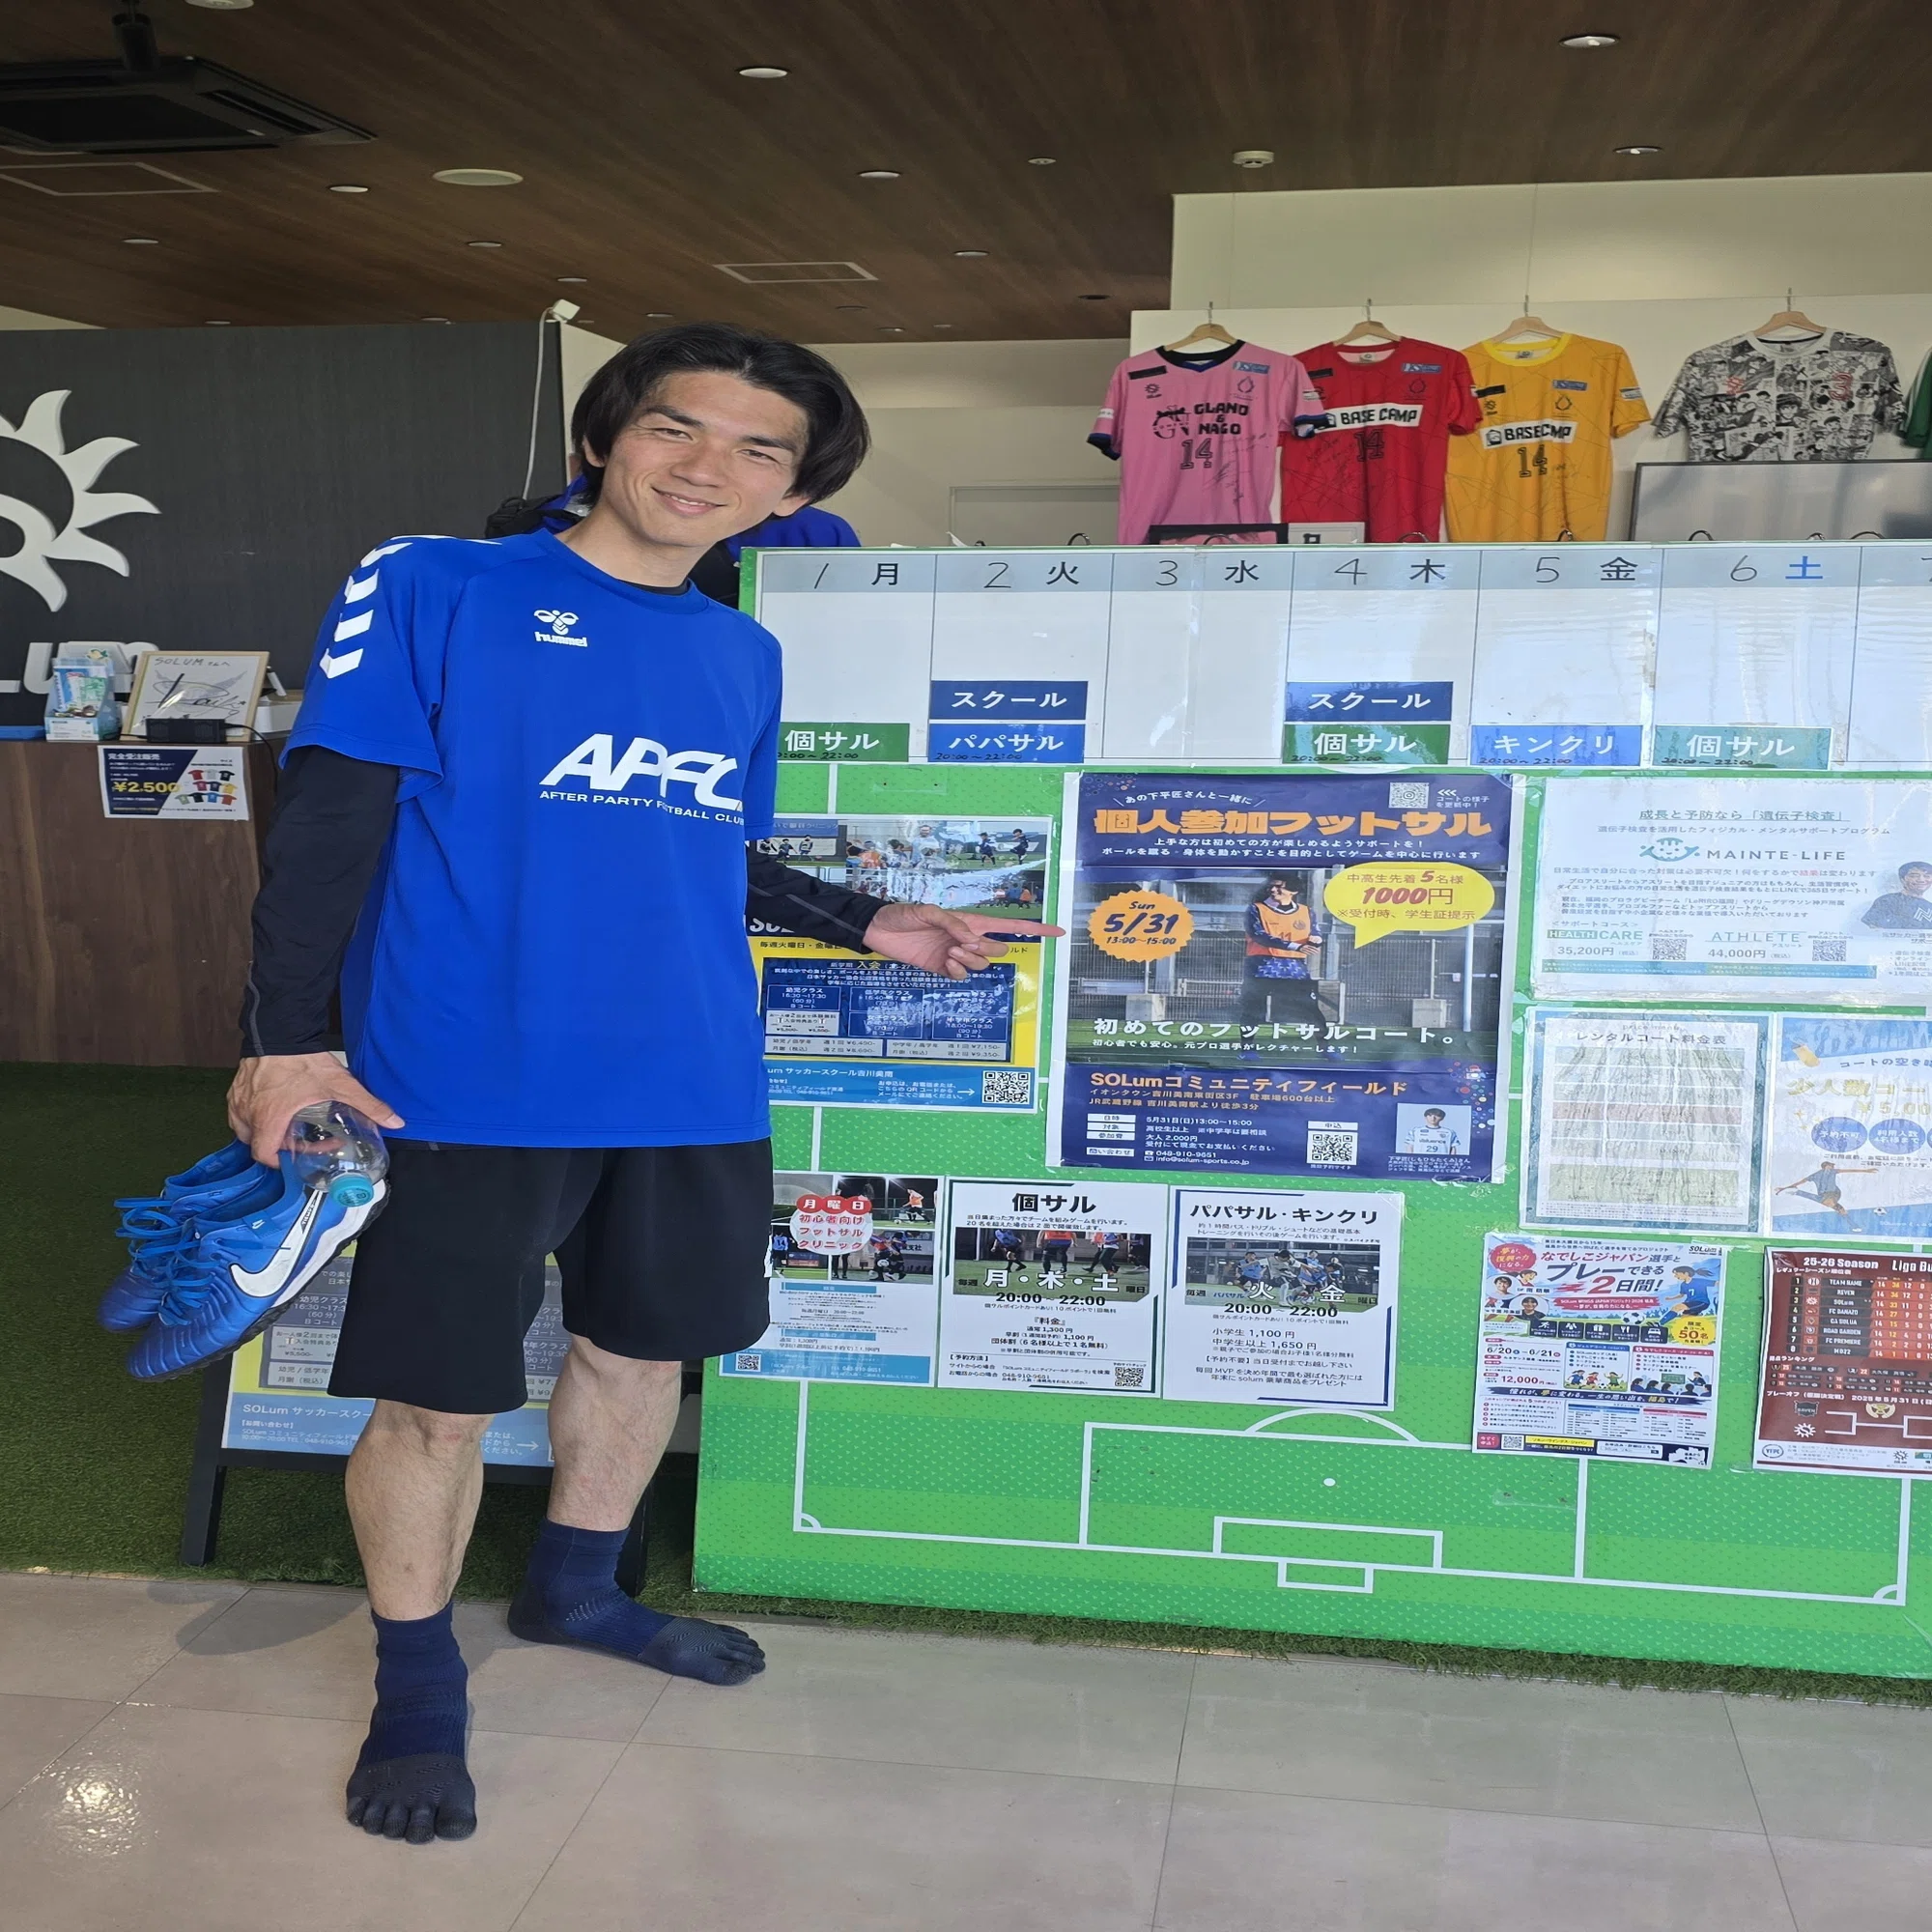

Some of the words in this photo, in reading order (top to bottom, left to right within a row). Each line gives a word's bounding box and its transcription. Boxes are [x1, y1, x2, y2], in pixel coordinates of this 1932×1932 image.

[1194, 403, 1249, 416] GLAND
[1341, 408, 1376, 425] BASE
[1378, 408, 1418, 423] CAMP
[1198, 423, 1241, 435] NAGO
[1180, 438, 1213, 469] 14
[1354, 428, 1385, 462] 14
[1518, 444, 1548, 478] 14
[870, 563, 899, 586] 月
[983, 561, 1012, 588] 2
[1046, 561, 1080, 585] 火
[1155, 560, 1179, 586] 3
[1224, 559, 1260, 584] 水
[1333, 557, 1367, 585] 4
[1408, 558, 1446, 582] 木
[1535, 556, 1560, 582] 5
[1599, 555, 1638, 582] 金
[1729, 554, 1757, 582] 6
[1785, 555, 1823, 580] 土
[534, 631, 588, 647] hummel
[952, 691, 1067, 709] スクール
[1308, 692, 1432, 710] スクール
[784, 729, 880, 752] 個サル
[949, 734, 1064, 753] パパサル
[1314, 732, 1417, 755] 個サル
[1493, 734, 1615, 755] キンクリ
[1687, 734, 1796, 757] 個サル
[539, 790, 588, 803] AFTER
[592, 794, 654, 808] PARTY
[1094, 809, 1492, 838] 個人参加フットサル
[1707, 850, 1846, 861] MAINTE-LIFE
[1128, 900, 1155, 910] Sun
[1362, 887, 1454, 905] 1000円
[1103, 912, 1179, 936] 5/31
[1711, 931, 1801, 943] ATHLETE
[1557, 946, 1614, 955] 35,200円
[1707, 949, 1766, 959] 44,000円
[1094, 1017, 1454, 1044] 初めてのフットサルコート。
[1577, 1033, 1726, 1045] レンタルコート料金表
[1091, 1072, 1408, 1096] SOLumコミュニティフィールド
[1426, 1145, 1438, 1153] 29
[1012, 1192, 1097, 1214] 個サル
[799, 1214, 865, 1225] 初心者向け
[1189, 1204, 1378, 1225] パパサル・キンクリ
[799, 1227, 865, 1237] フットサル
[797, 1239, 863, 1250] クリニック
[1541, 1251, 1682, 1264] なでしこジャパン選手と
[1836, 1258, 1879, 1269] Season
[1547, 1262, 1664, 1283] プレーできる
[995, 1292, 1042, 1304] 20:00
[1059, 1294, 1106, 1306] 22:00
[1249, 1281, 1276, 1301] 火
[1319, 1282, 1347, 1303] 金
[1224, 1303, 1272, 1315] 20:00
[1290, 1306, 1339, 1318] 22:00
[1211, 1327, 1245, 1337] 小学生
[1249, 1329, 1282, 1339] 1,100
[1678, 1329, 1709, 1340] 50名
[1211, 1338, 1267, 1349] 中学生以上
[1270, 1340, 1303, 1350] 1,650
[242, 1404, 289, 1415] SOLum
